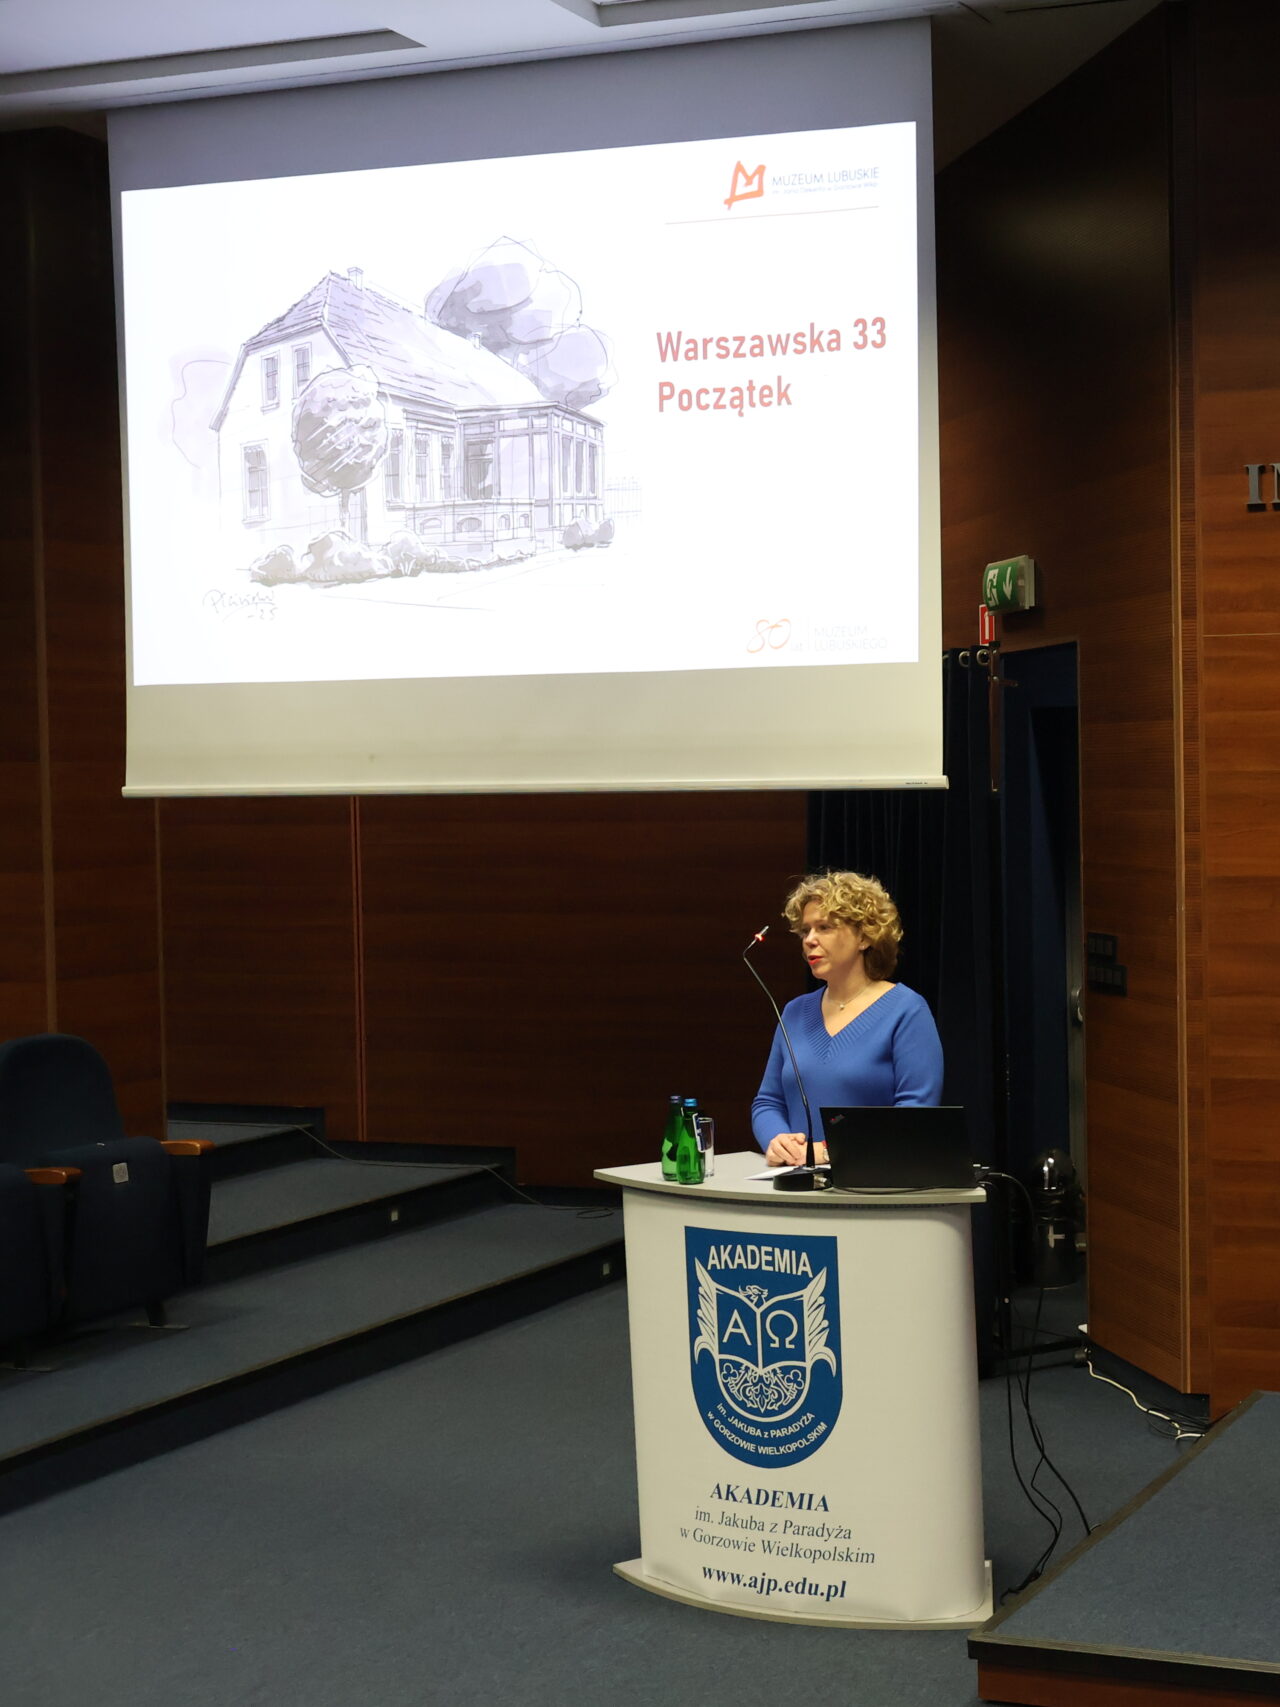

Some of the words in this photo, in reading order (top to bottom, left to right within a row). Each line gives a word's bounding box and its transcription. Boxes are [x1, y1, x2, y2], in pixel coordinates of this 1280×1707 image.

[772, 172, 824, 186] MUZEUM
[828, 166, 880, 183] LUBUSKIE
[656, 322, 842, 363] Warszawska
[852, 316, 887, 351] 33
[658, 375, 793, 418] Początek
[707, 1244, 814, 1278] AKADEMIA
[707, 1411, 715, 1420] w
[713, 1419, 757, 1453] GORZOWIE
[757, 1421, 828, 1455] WIELKOPOLSKIM
[727, 1415, 762, 1438] JAKUBA
[770, 1412, 816, 1438] PARADYŻA
[710, 1482, 830, 1513] AKADEMIA
[695, 1505, 714, 1524] im.
[718, 1511, 765, 1532] Jakuba
[769, 1522, 778, 1533] z
[783, 1519, 852, 1542] Paradyża
[680, 1527, 690, 1538] w
[693, 1527, 756, 1553] Gorzowie
[761, 1539, 876, 1564] Wielkopolskim
[702, 1566, 847, 1602] www.ajp.edu.pl
